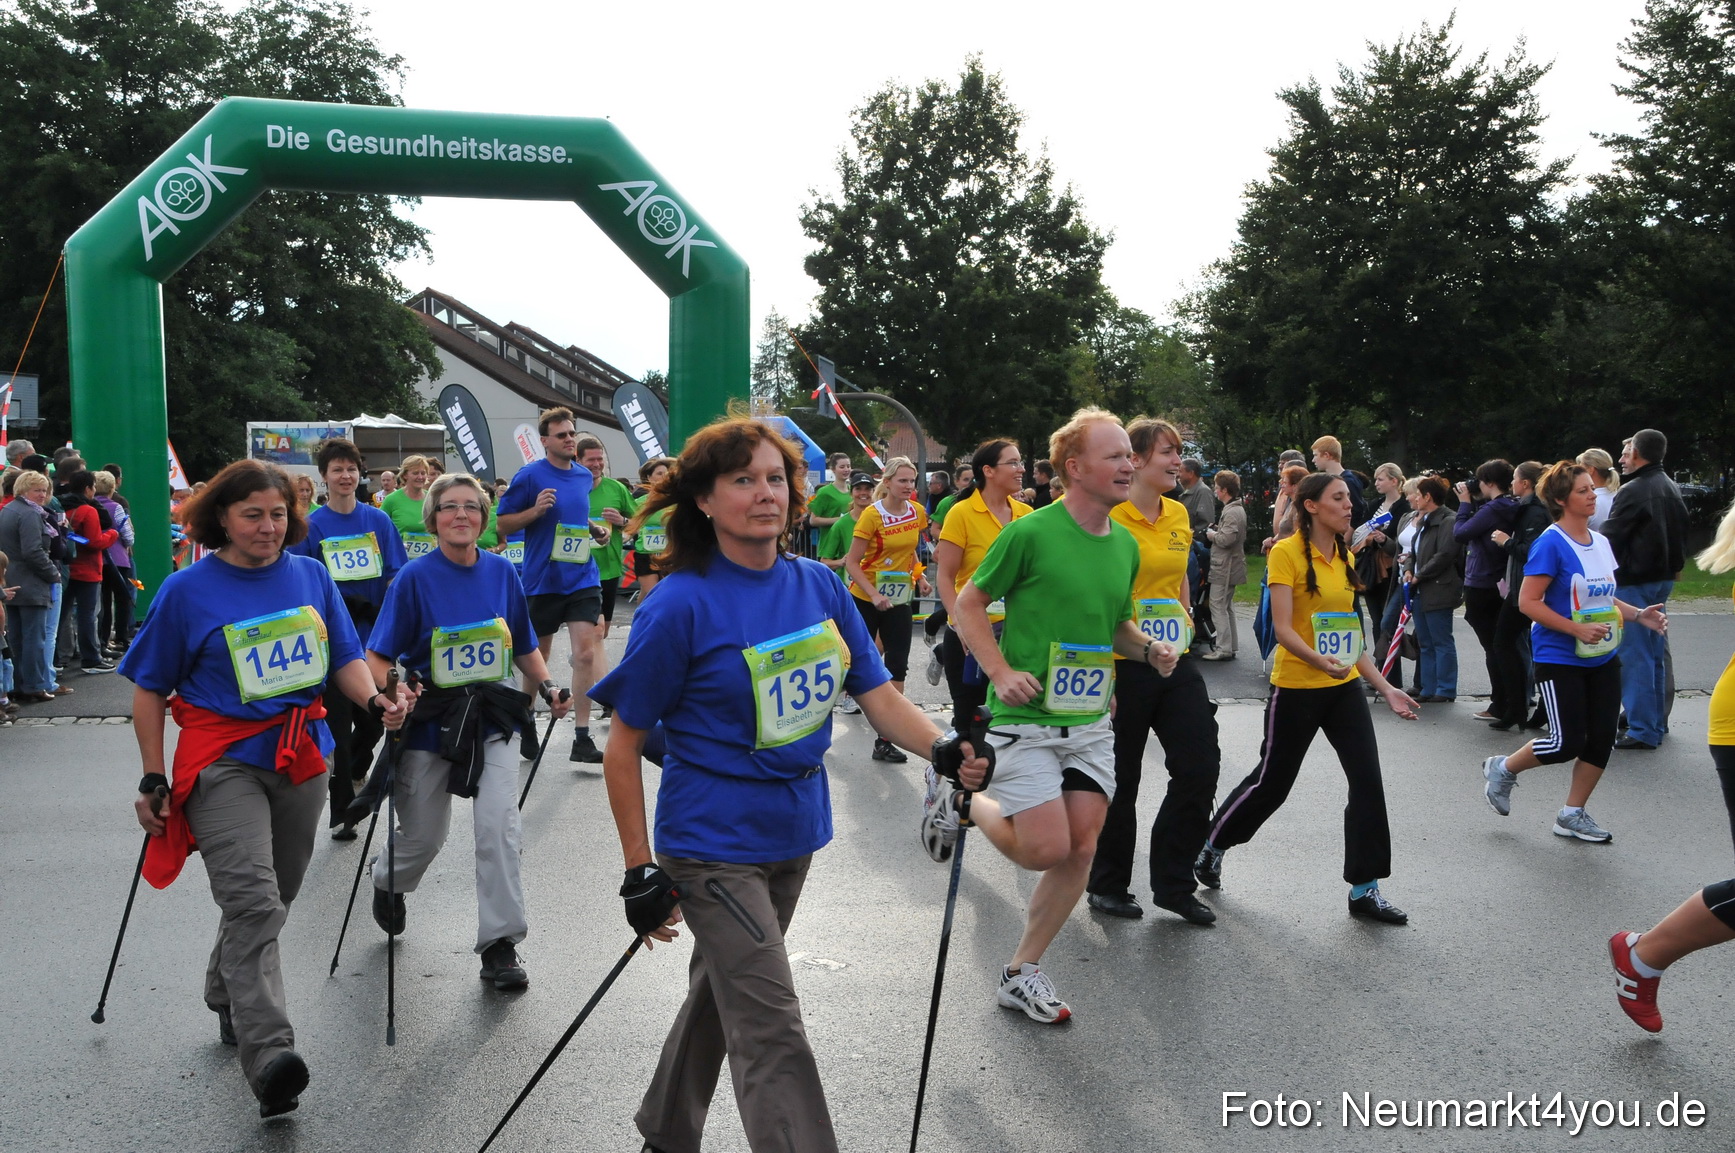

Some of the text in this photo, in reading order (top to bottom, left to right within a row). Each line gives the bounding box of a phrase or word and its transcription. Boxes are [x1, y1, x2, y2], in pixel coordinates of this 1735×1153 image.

[266, 124, 573, 164] Die Gesundheitskasse.
[137, 133, 249, 262] AOK
[597, 180, 718, 279] AOK
[255, 437, 291, 450] TLA
[884, 527, 902, 536] MAX
[406, 541, 429, 554] 752
[504, 548, 522, 559] 169
[562, 537, 583, 553] 87
[331, 549, 370, 570] 138
[878, 583, 906, 597] 437
[1587, 583, 1615, 598] TeVi
[1141, 618, 1180, 642] 690
[1318, 631, 1352, 655] 691
[245, 634, 313, 679] 144
[442, 641, 496, 671] 136
[261, 674, 284, 687] Maria
[452, 670, 472, 678] Gundi
[1053, 667, 1104, 697] 862
[769, 660, 835, 718] 135
[776, 709, 813, 730] Elisabeth
